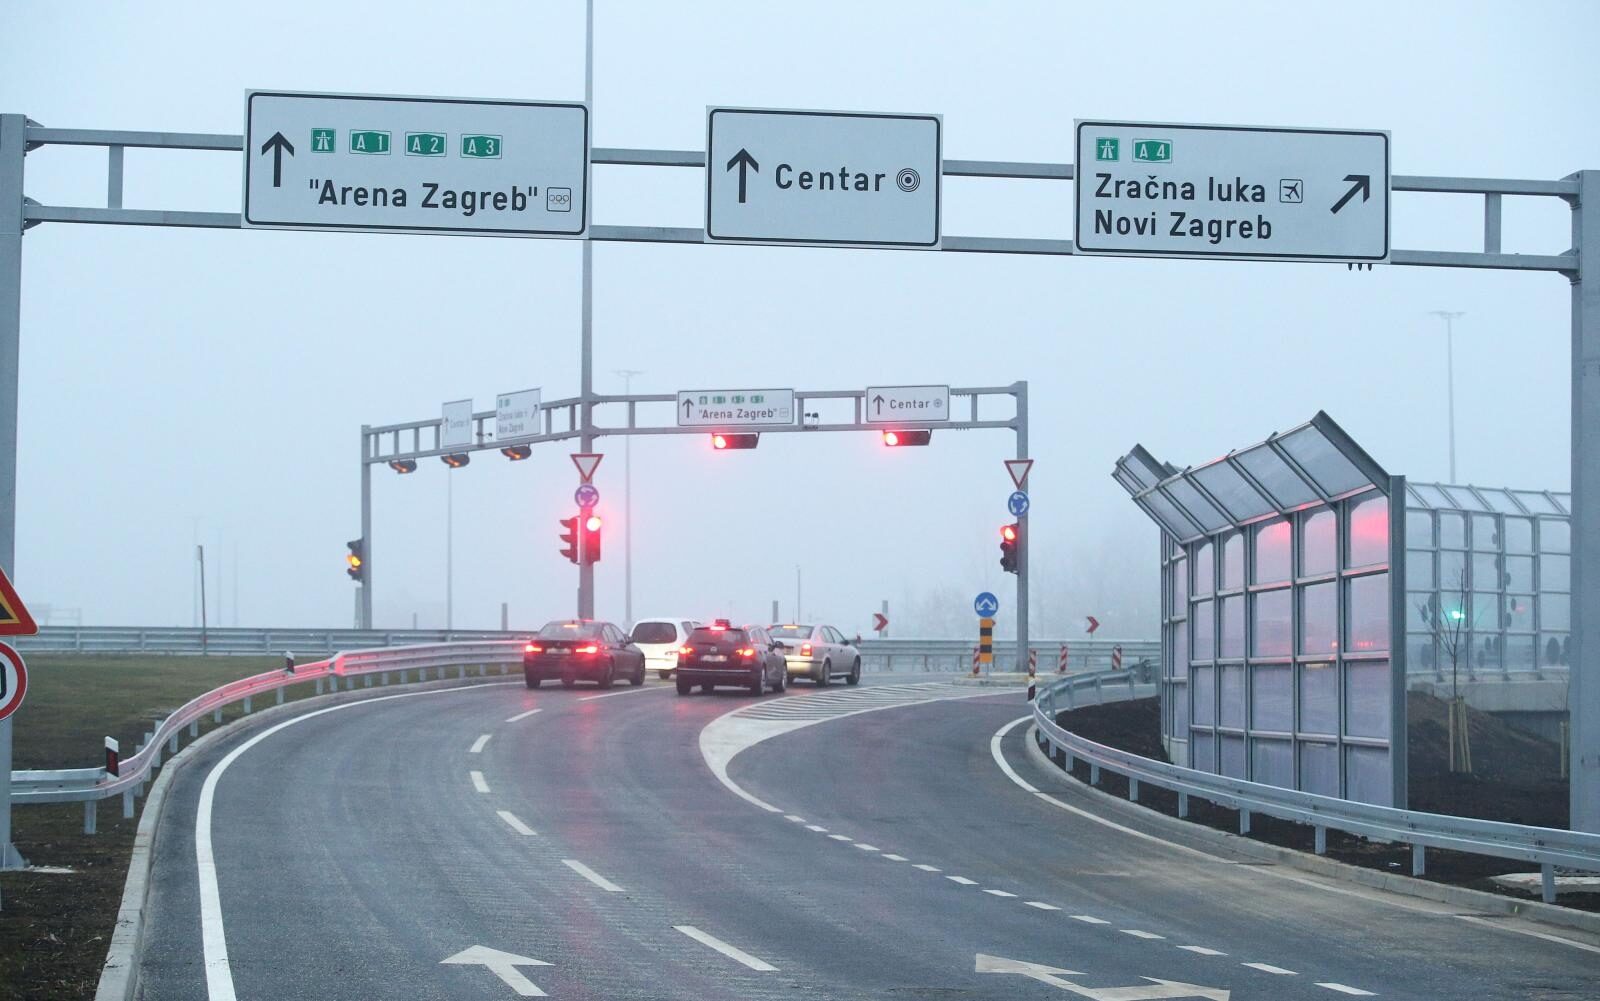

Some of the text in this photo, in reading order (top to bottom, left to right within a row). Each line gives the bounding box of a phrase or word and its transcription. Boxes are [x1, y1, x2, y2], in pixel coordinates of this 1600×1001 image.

[775, 163, 886, 192] Centar
[1095, 172, 1266, 203] Zračna luka
[309, 178, 538, 217] "Arena Zagreb"
[1095, 209, 1273, 244] Novi Zagreb
[699, 408, 778, 420] "Arena Zagreb"
[890, 399, 930, 409] Centar
